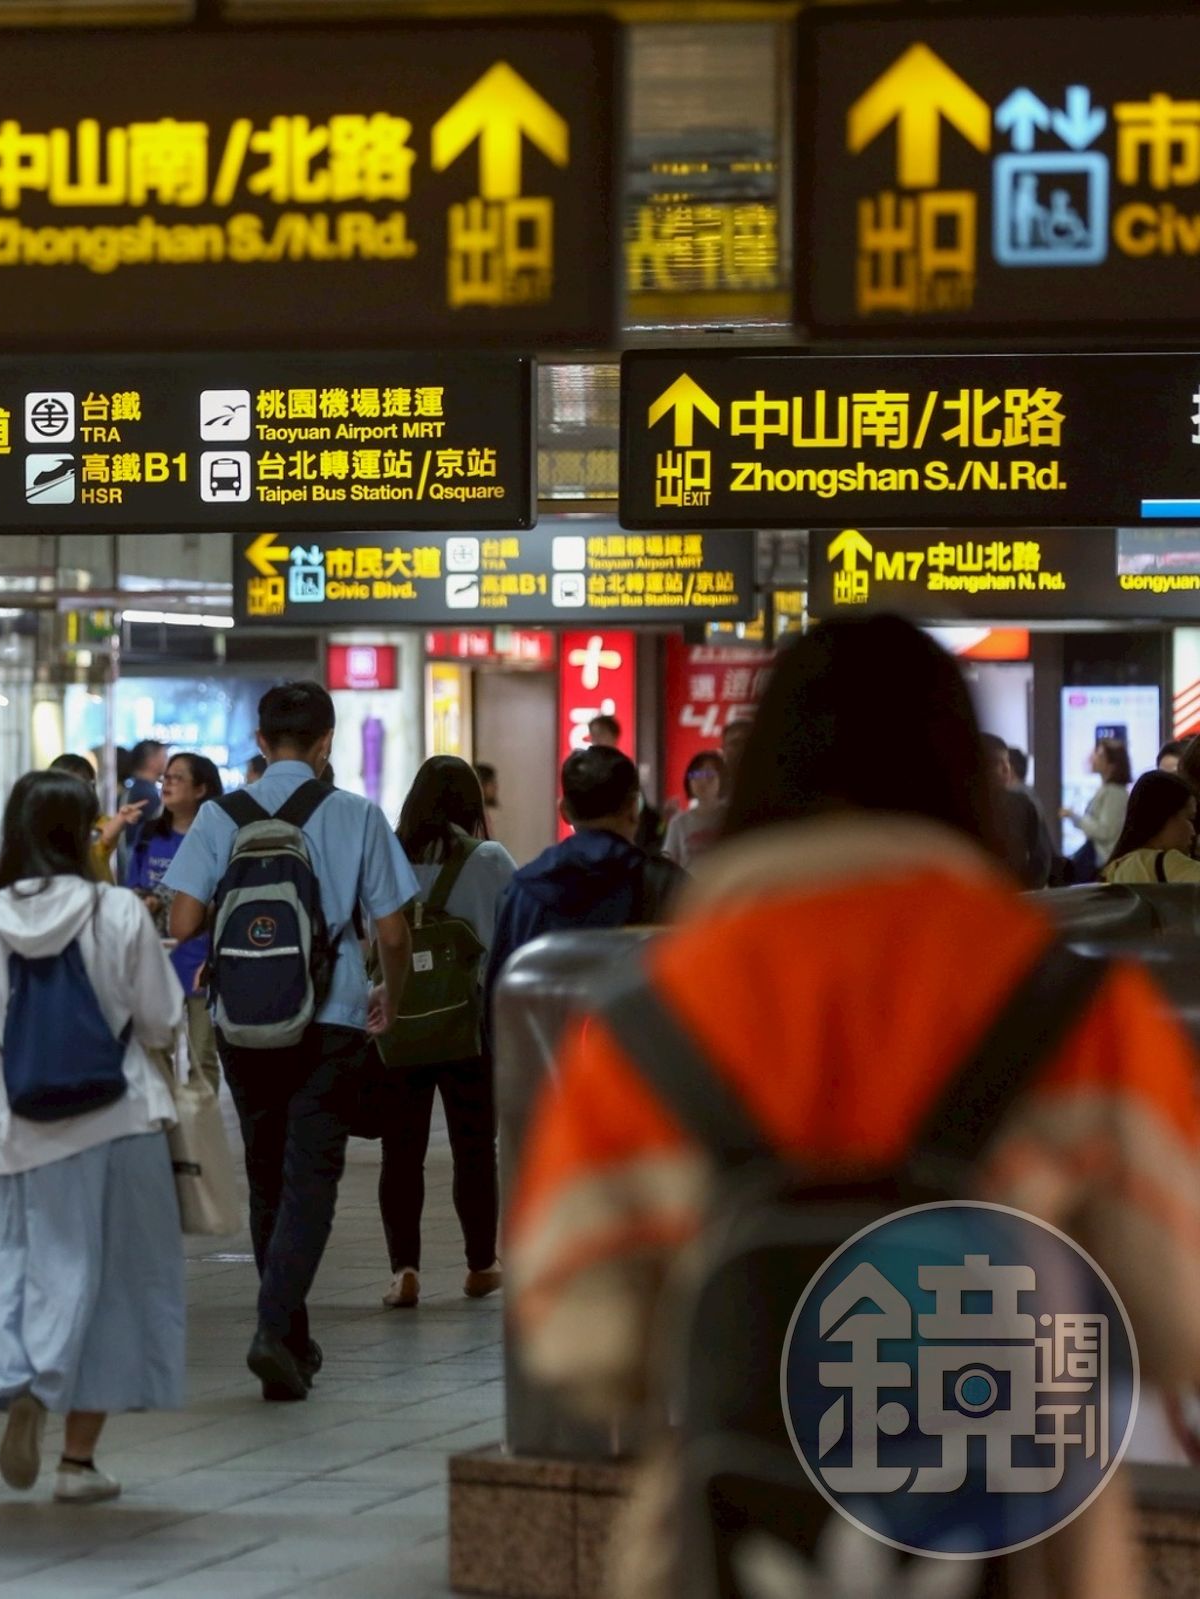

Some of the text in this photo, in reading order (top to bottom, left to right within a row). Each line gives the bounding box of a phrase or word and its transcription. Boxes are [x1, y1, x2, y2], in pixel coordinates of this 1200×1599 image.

[449, 198, 552, 306] 出口
[861, 192, 976, 308] 出口
[82, 391, 141, 421] 台鐵
[256, 387, 443, 419] 桃園機場捷運
[256, 422, 445, 443] Taoyuan Airport MRT
[731, 388, 1065, 449] 中山南/北路
[80, 427, 121, 442] TRA
[82, 453, 186, 483] 高鐵B1
[656, 450, 711, 507] 出口
[730, 462, 919, 498] Zhongshan
[82, 488, 122, 503] HSR
[256, 483, 504, 504] Taipei Bus Station Qsquare
[683, 490, 711, 505] EXIT
[325, 547, 441, 578] 市民大道
[875, 552, 924, 581] M7
[928, 541, 1041, 573] 中山北路
[325, 580, 416, 599] Civic Blvd.
[833, 570, 868, 603] 出口
[927, 572, 1065, 593] Zhongshan N. Rd.
